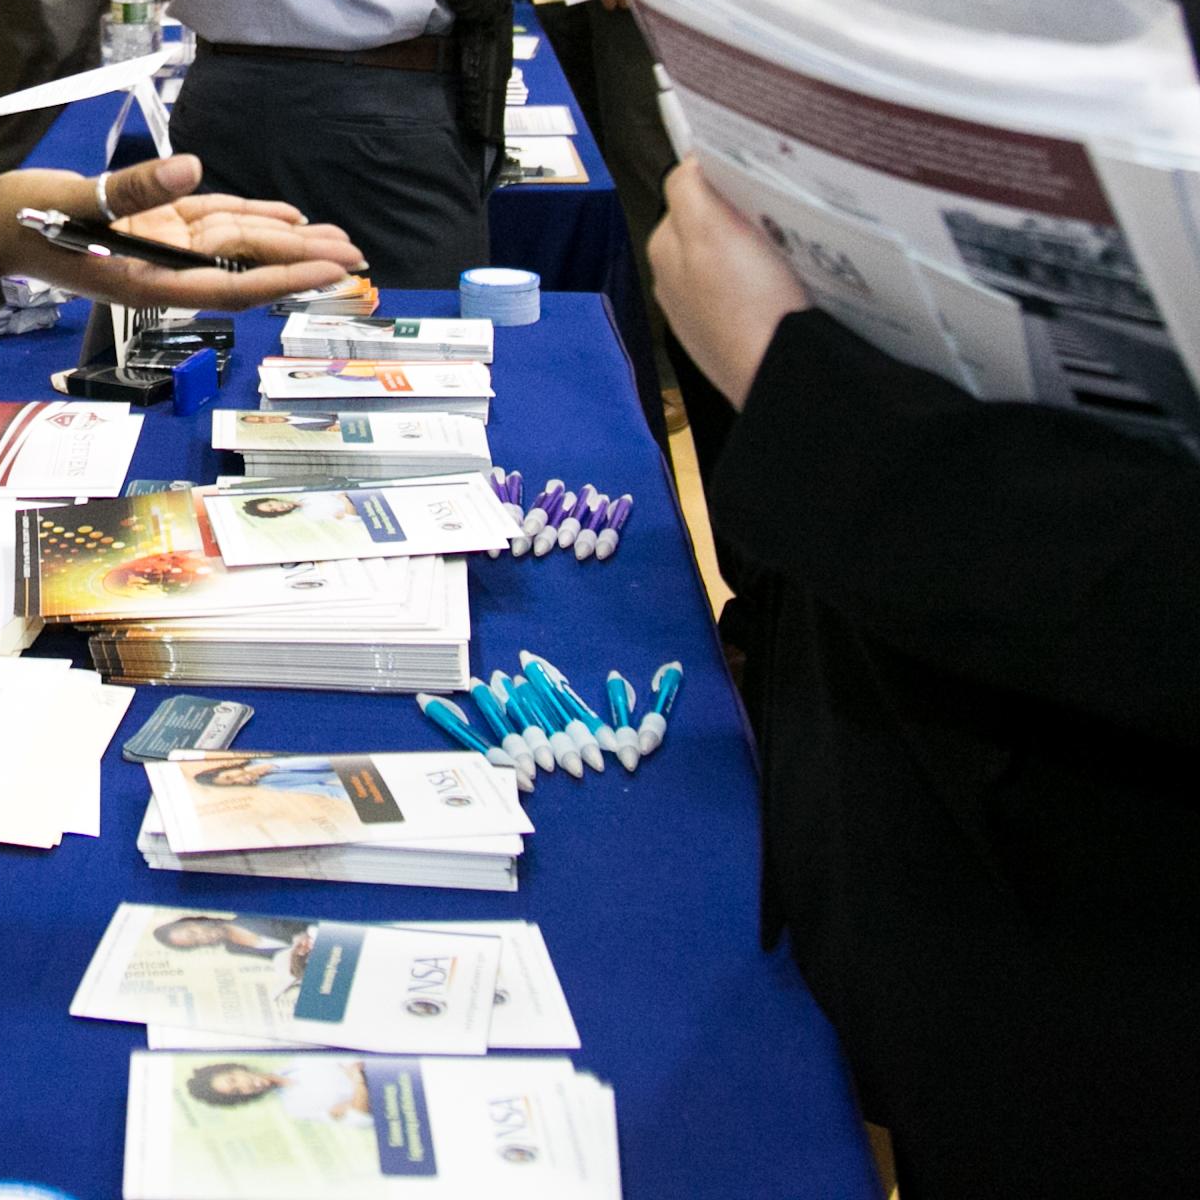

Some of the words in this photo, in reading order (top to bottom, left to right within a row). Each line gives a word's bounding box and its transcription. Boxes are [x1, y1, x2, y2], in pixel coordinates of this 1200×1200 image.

[426, 770, 463, 795] NSA
[407, 955, 450, 996] NSA
[487, 1097, 529, 1138] NSA
